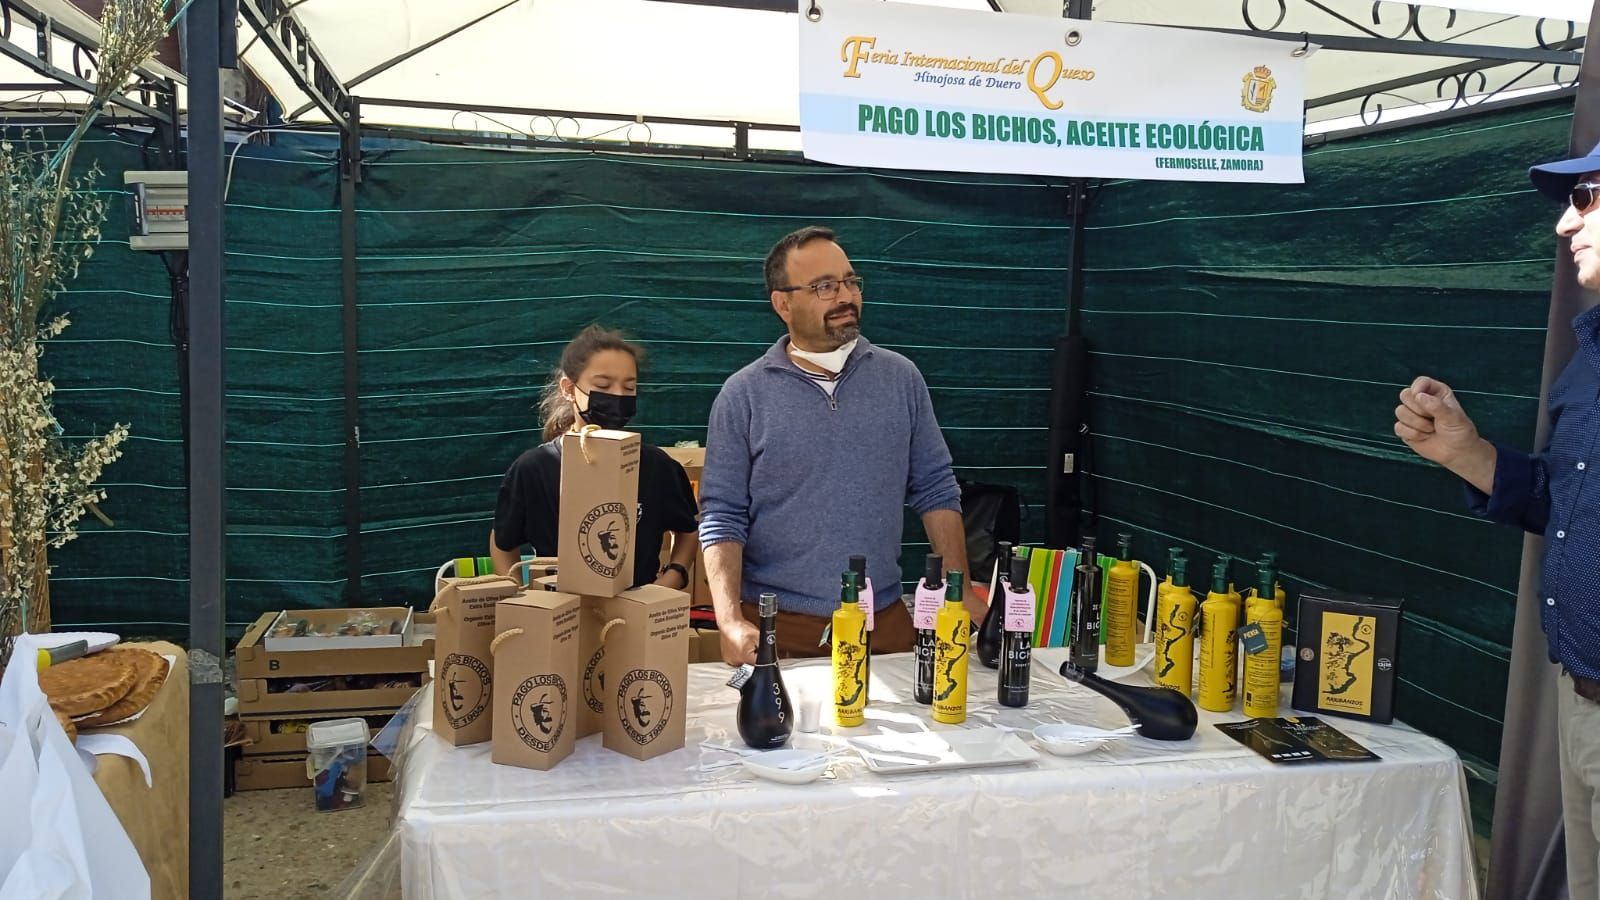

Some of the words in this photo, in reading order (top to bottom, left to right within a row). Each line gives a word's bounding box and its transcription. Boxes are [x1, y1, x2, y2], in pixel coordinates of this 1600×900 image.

[841, 35, 899, 78] Feria
[900, 50, 1006, 74] Internacional
[1001, 58, 1030, 75] del
[1027, 51, 1095, 110] Queso
[913, 70, 966, 87] Hinojosa
[969, 75, 982, 87] de
[986, 77, 1022, 90] Duero
[858, 103, 919, 135] PAGO
[925, 109, 967, 139] LOS
[972, 113, 1062, 147] BICHOS,
[1066, 120, 1141, 148] ACEITE
[1145, 120, 1265, 152] ECOLÓGICA
[1155, 156, 1220, 171] (FERMOSELLE,
[1220, 158, 1264, 172] ZAMORA)
[580, 509, 601, 534] PAGO
[602, 504, 619, 513] LOS
[922, 638, 935, 647] LA
[1020, 641, 1031, 650] LA
[269, 659, 280, 671] B
[463, 656, 491, 686] BICHOS
[512, 680, 533, 706] PAGO
[534, 676, 551, 685] LOS
[618, 674, 634, 698] PAGO
[633, 671, 648, 680] LOS
[649, 671, 673, 698] BICHOS
[518, 726, 550, 751] DESDE
[621, 718, 647, 744] DESDE
